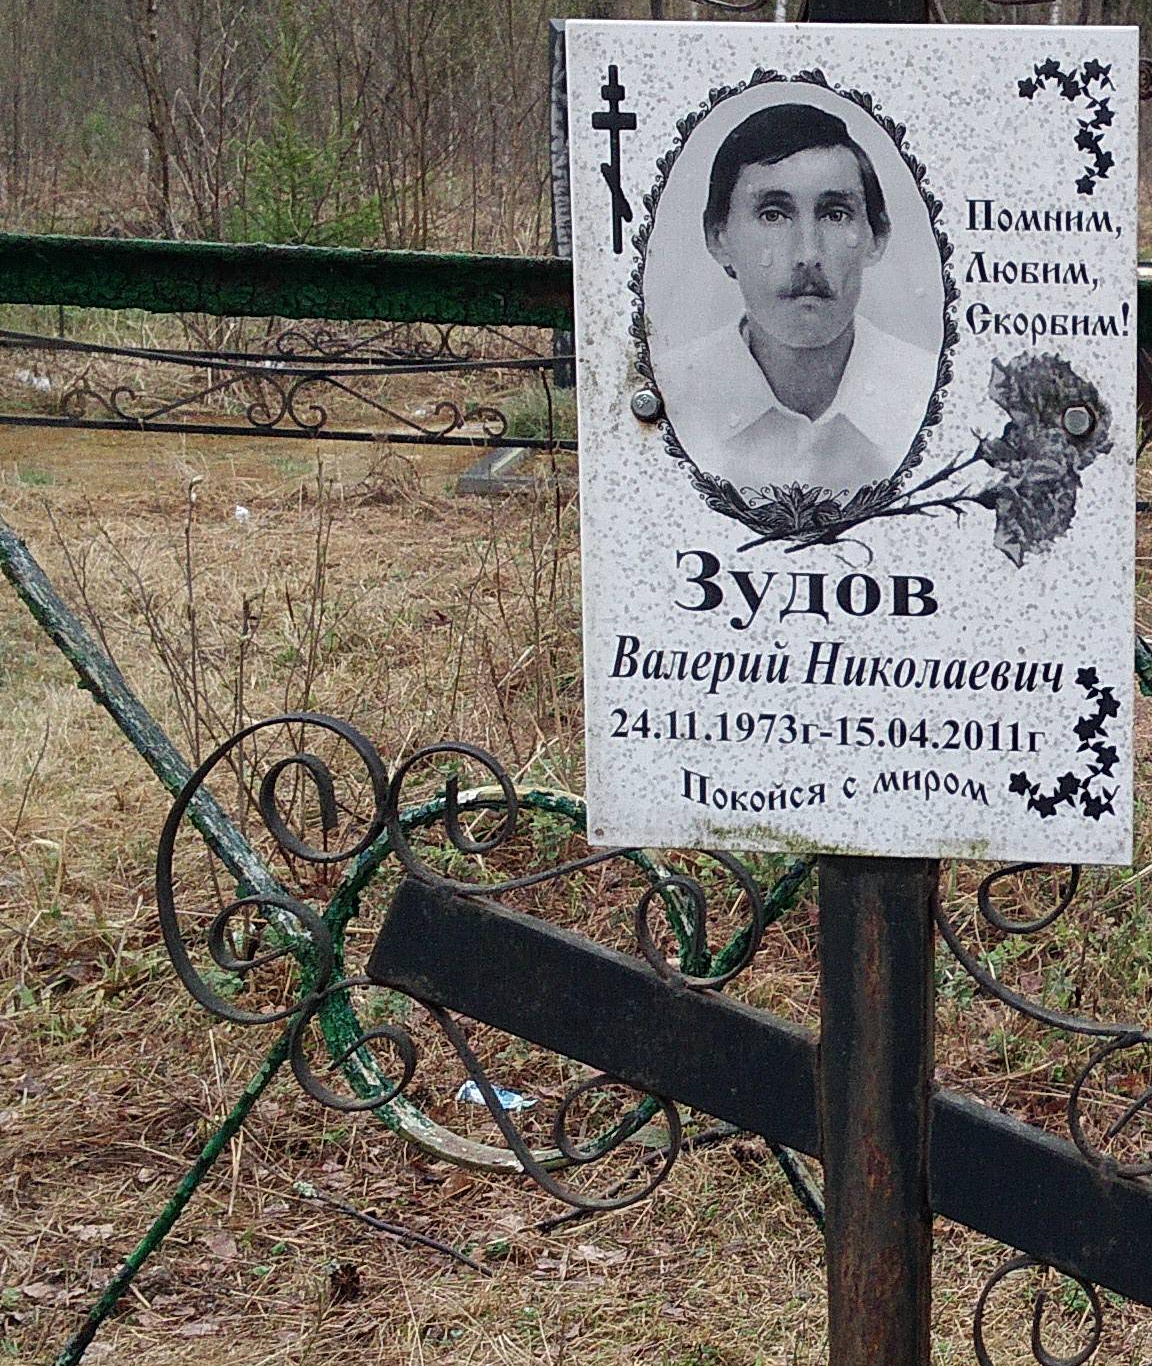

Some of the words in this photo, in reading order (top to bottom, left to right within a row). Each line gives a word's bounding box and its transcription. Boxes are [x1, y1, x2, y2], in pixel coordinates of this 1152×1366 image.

[965, 198, 1122, 239] Помним,
[965, 251, 1098, 291] Любим,
[965, 301, 1130, 346] Скорбим!
[673, 549, 939, 630] Зудов
[608, 635, 791, 694] Валерий
[801, 641, 1064, 693] Николаевич
[610, 708, 1046, 753] 24.11.1973г-15.04.2011г
[680, 767, 827, 813] Покойся
[842, 776, 857, 799] с
[872, 770, 990, 806] миром
